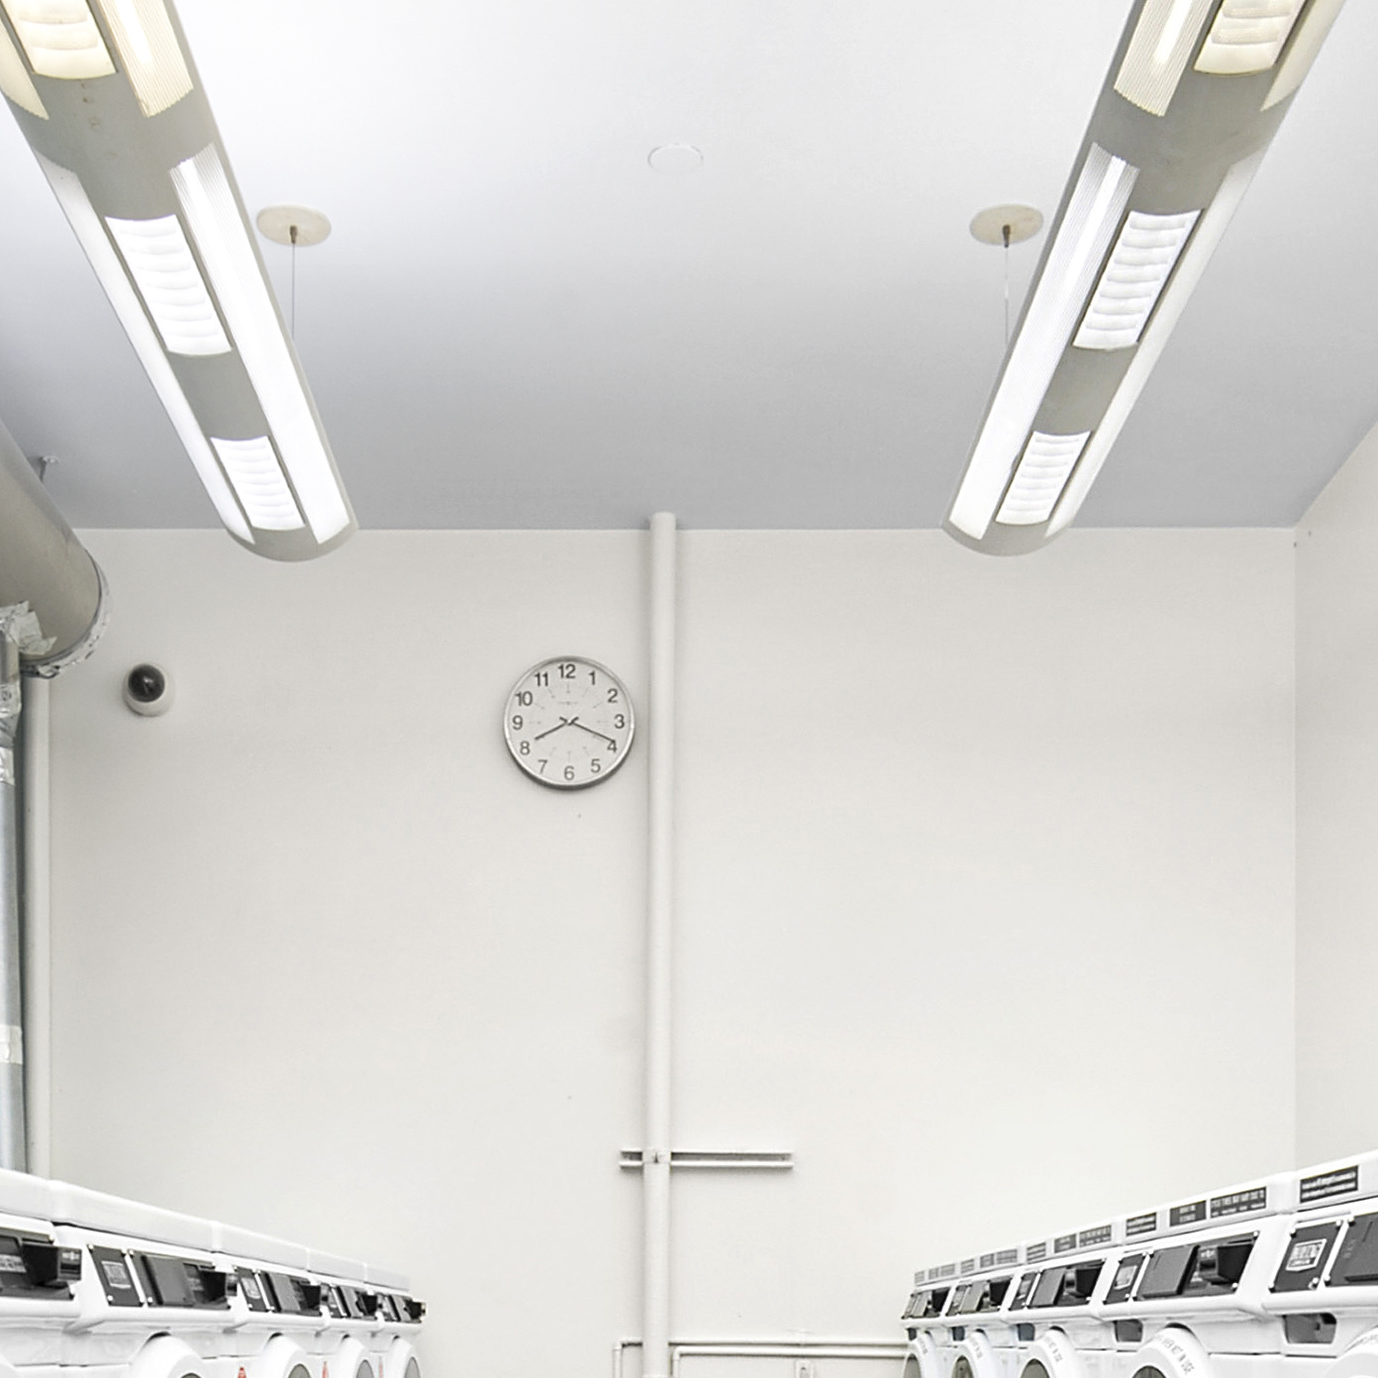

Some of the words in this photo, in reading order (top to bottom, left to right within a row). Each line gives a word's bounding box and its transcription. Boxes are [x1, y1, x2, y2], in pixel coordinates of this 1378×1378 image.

[558, 663, 576, 679] 12
[589, 671, 596, 685] 1
[534, 672, 549, 687] 11
[515, 691, 533, 706] 10
[607, 688, 619, 703] 2
[512, 715, 523, 730] 9
[614, 714, 625, 729] 3
[520, 741, 531, 755] 8
[607, 740, 617, 753] 4
[538, 759, 548, 774] 7
[564, 766, 575, 781] 6
[591, 759, 601, 773] 5
